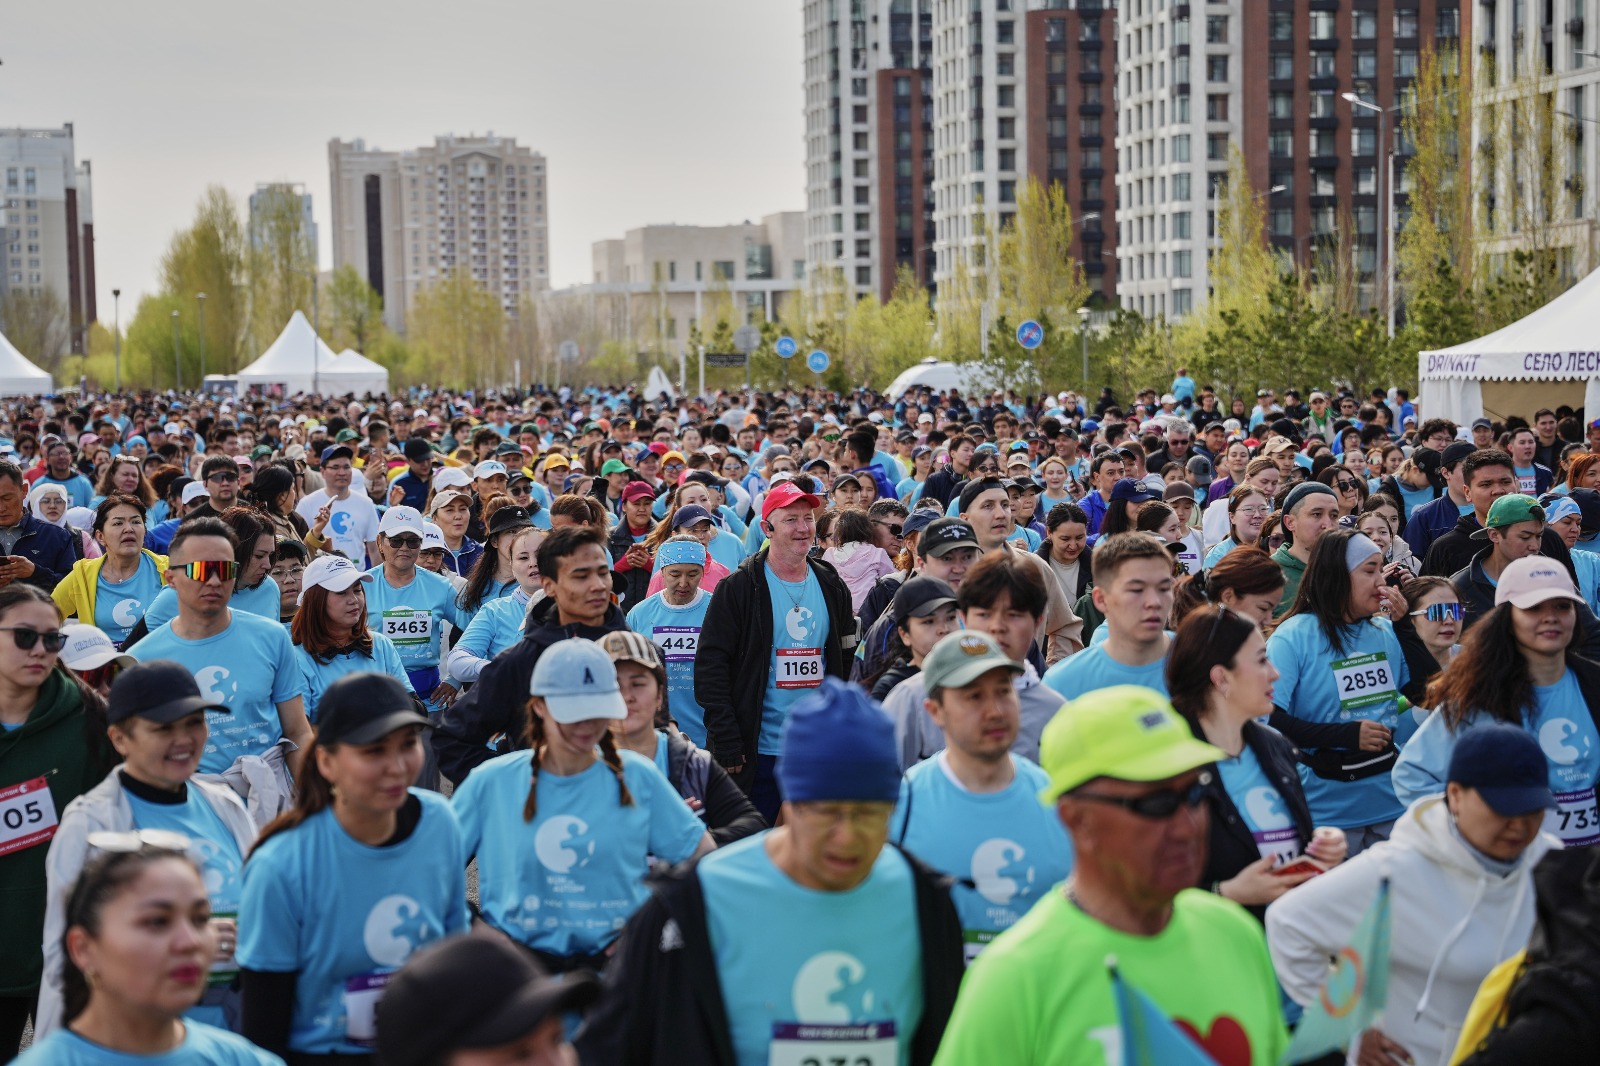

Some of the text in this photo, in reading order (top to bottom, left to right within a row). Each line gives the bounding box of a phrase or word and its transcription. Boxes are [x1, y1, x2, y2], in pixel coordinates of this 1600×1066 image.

[1427, 354, 1480, 372] DRINKIT
[1524, 353, 1562, 371] СЕЛО
[387, 621, 428, 634] 3463
[661, 637, 696, 650] 442
[583, 667, 595, 685] A
[783, 660, 818, 676] 1168
[1342, 667, 1389, 693] 2858
[210, 715, 236, 725] AUTISM
[1557, 768, 1573, 776] RUN
[1564, 772, 1590, 782] AUTISM
[3, 800, 43, 830] 05
